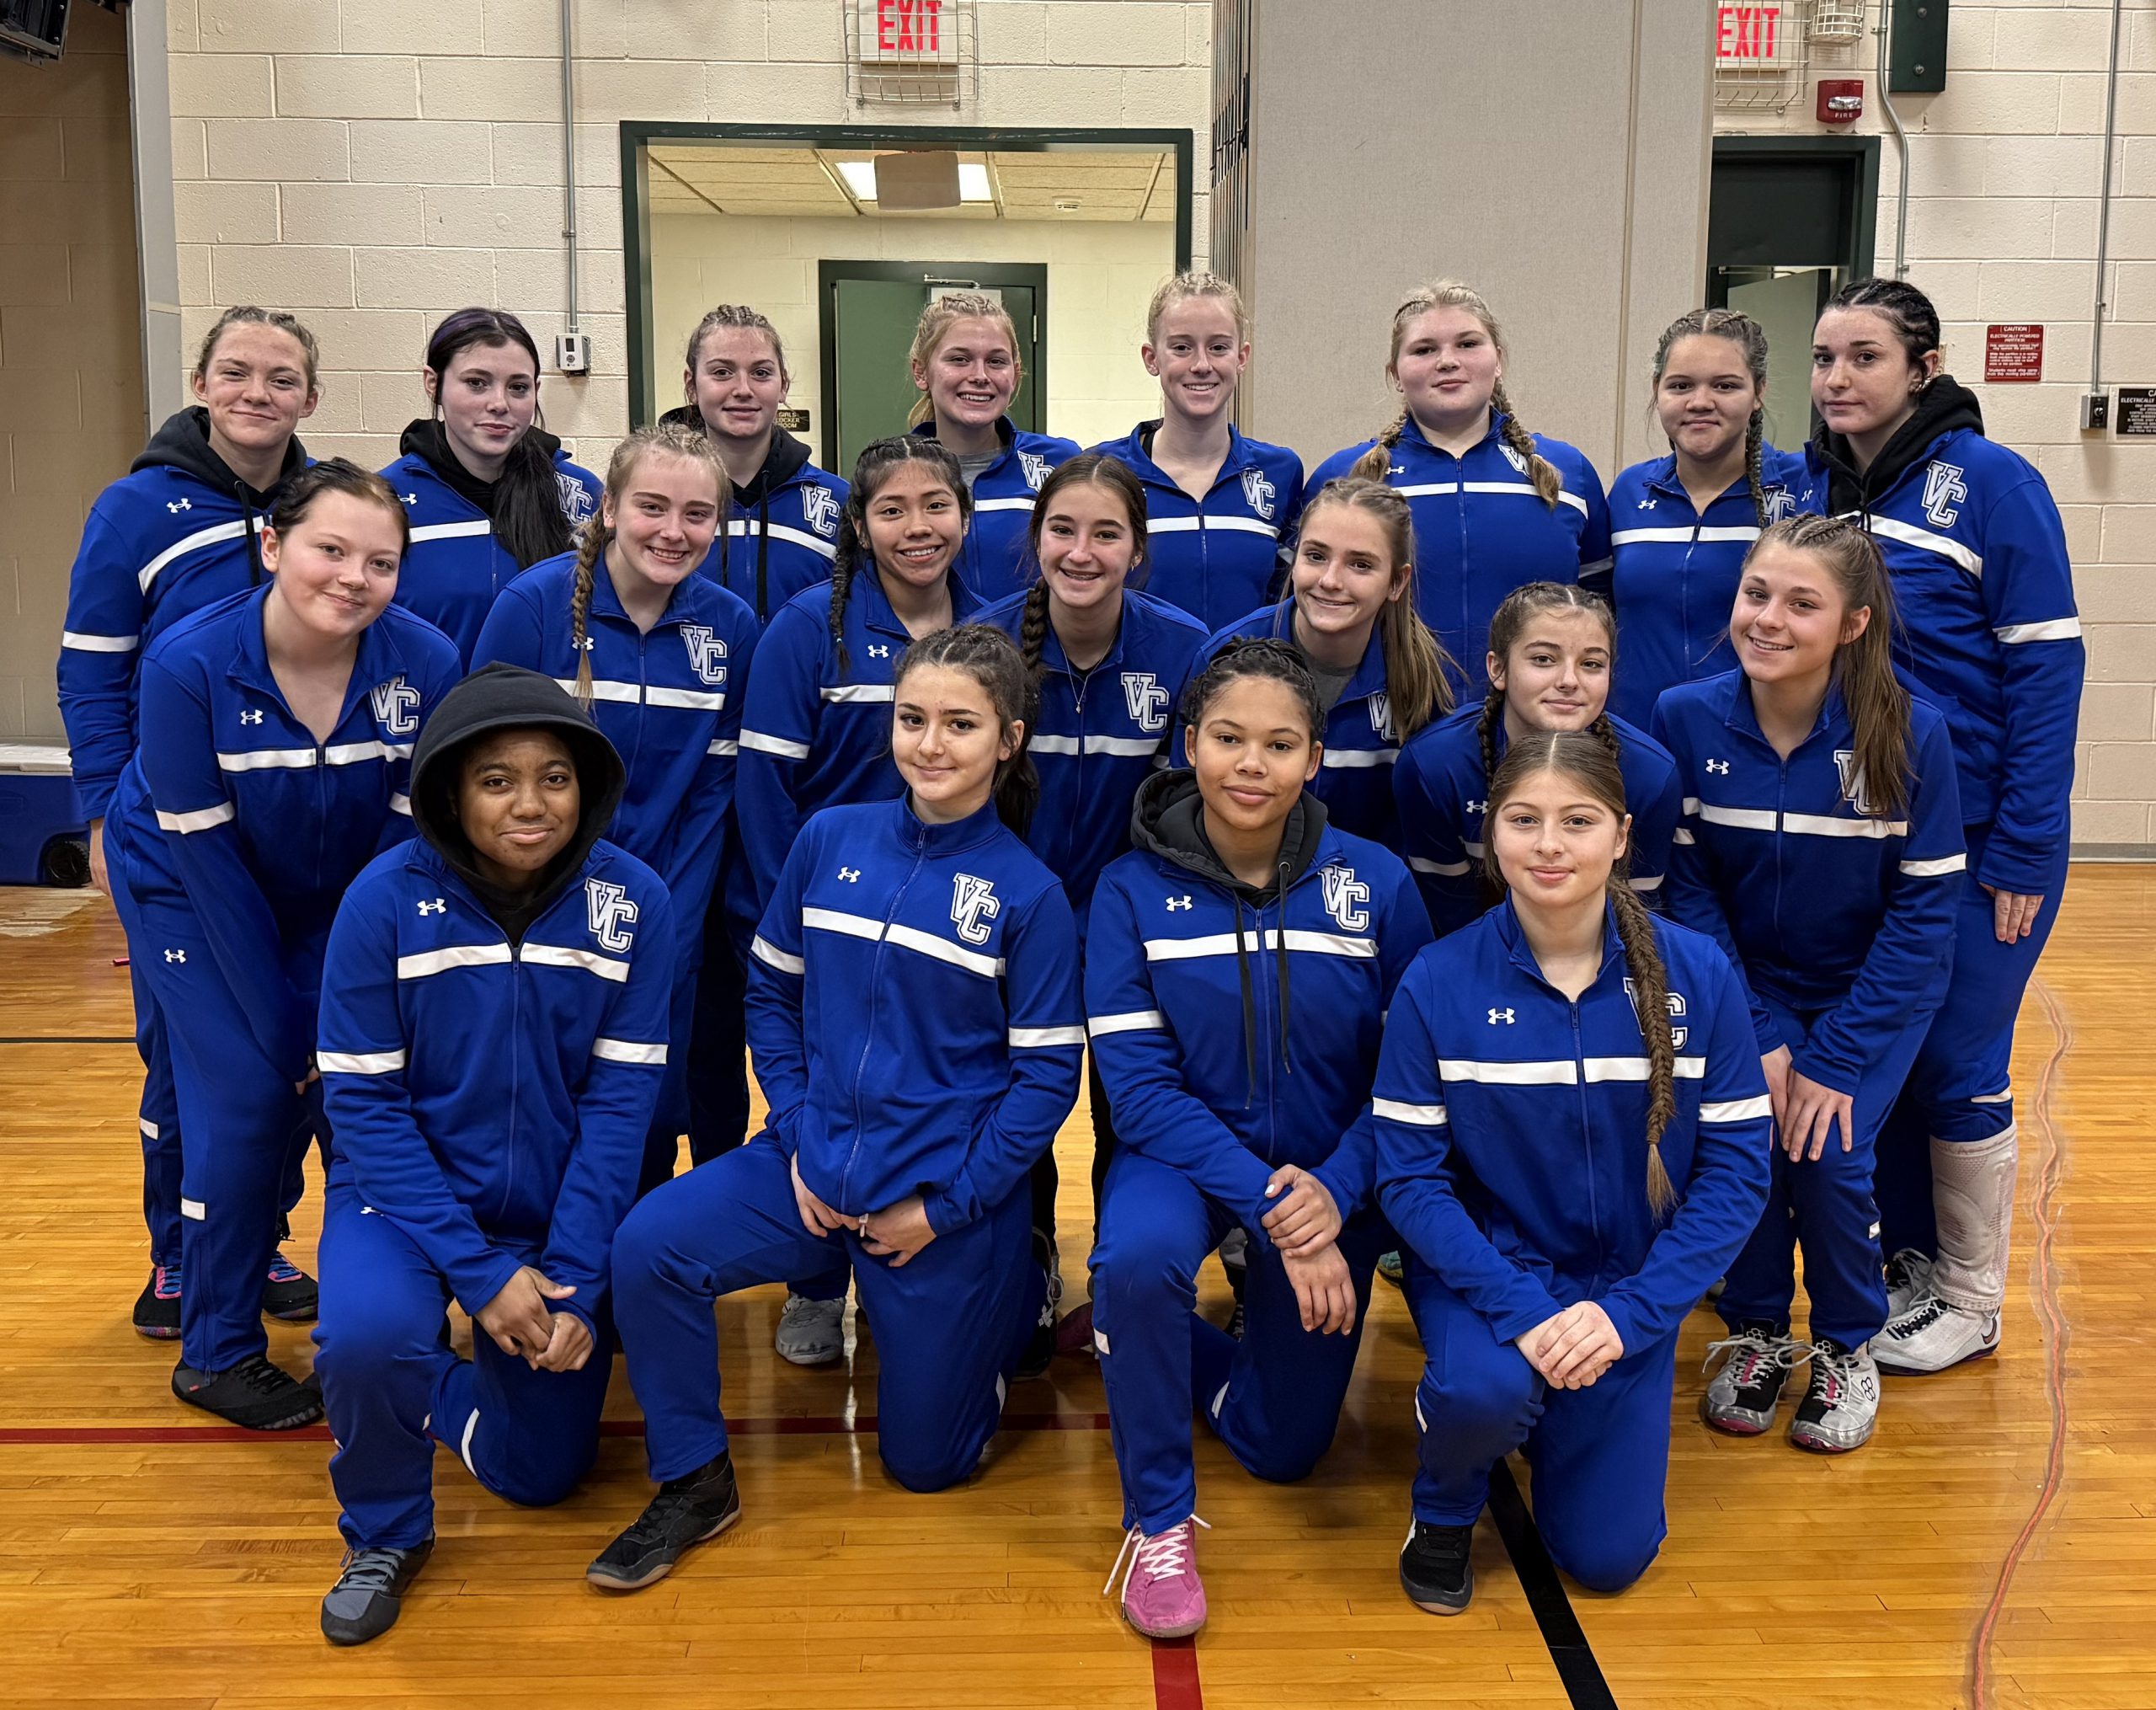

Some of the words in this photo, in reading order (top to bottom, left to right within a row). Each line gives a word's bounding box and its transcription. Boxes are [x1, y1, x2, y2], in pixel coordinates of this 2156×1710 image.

[878, 0, 942, 51] EXIT
[1716, 8, 1780, 57] EXIT
[554, 471, 593, 526] VC
[800, 483, 841, 537] VC
[1239, 469, 1276, 520] VC
[1922, 460, 1967, 528] VC
[680, 625, 727, 685] VC
[370, 675, 420, 735] VC
[1121, 672, 1170, 732] VC
[585, 878, 638, 953] VC
[950, 873, 1001, 945] VC
[1317, 866, 1369, 932] VC
